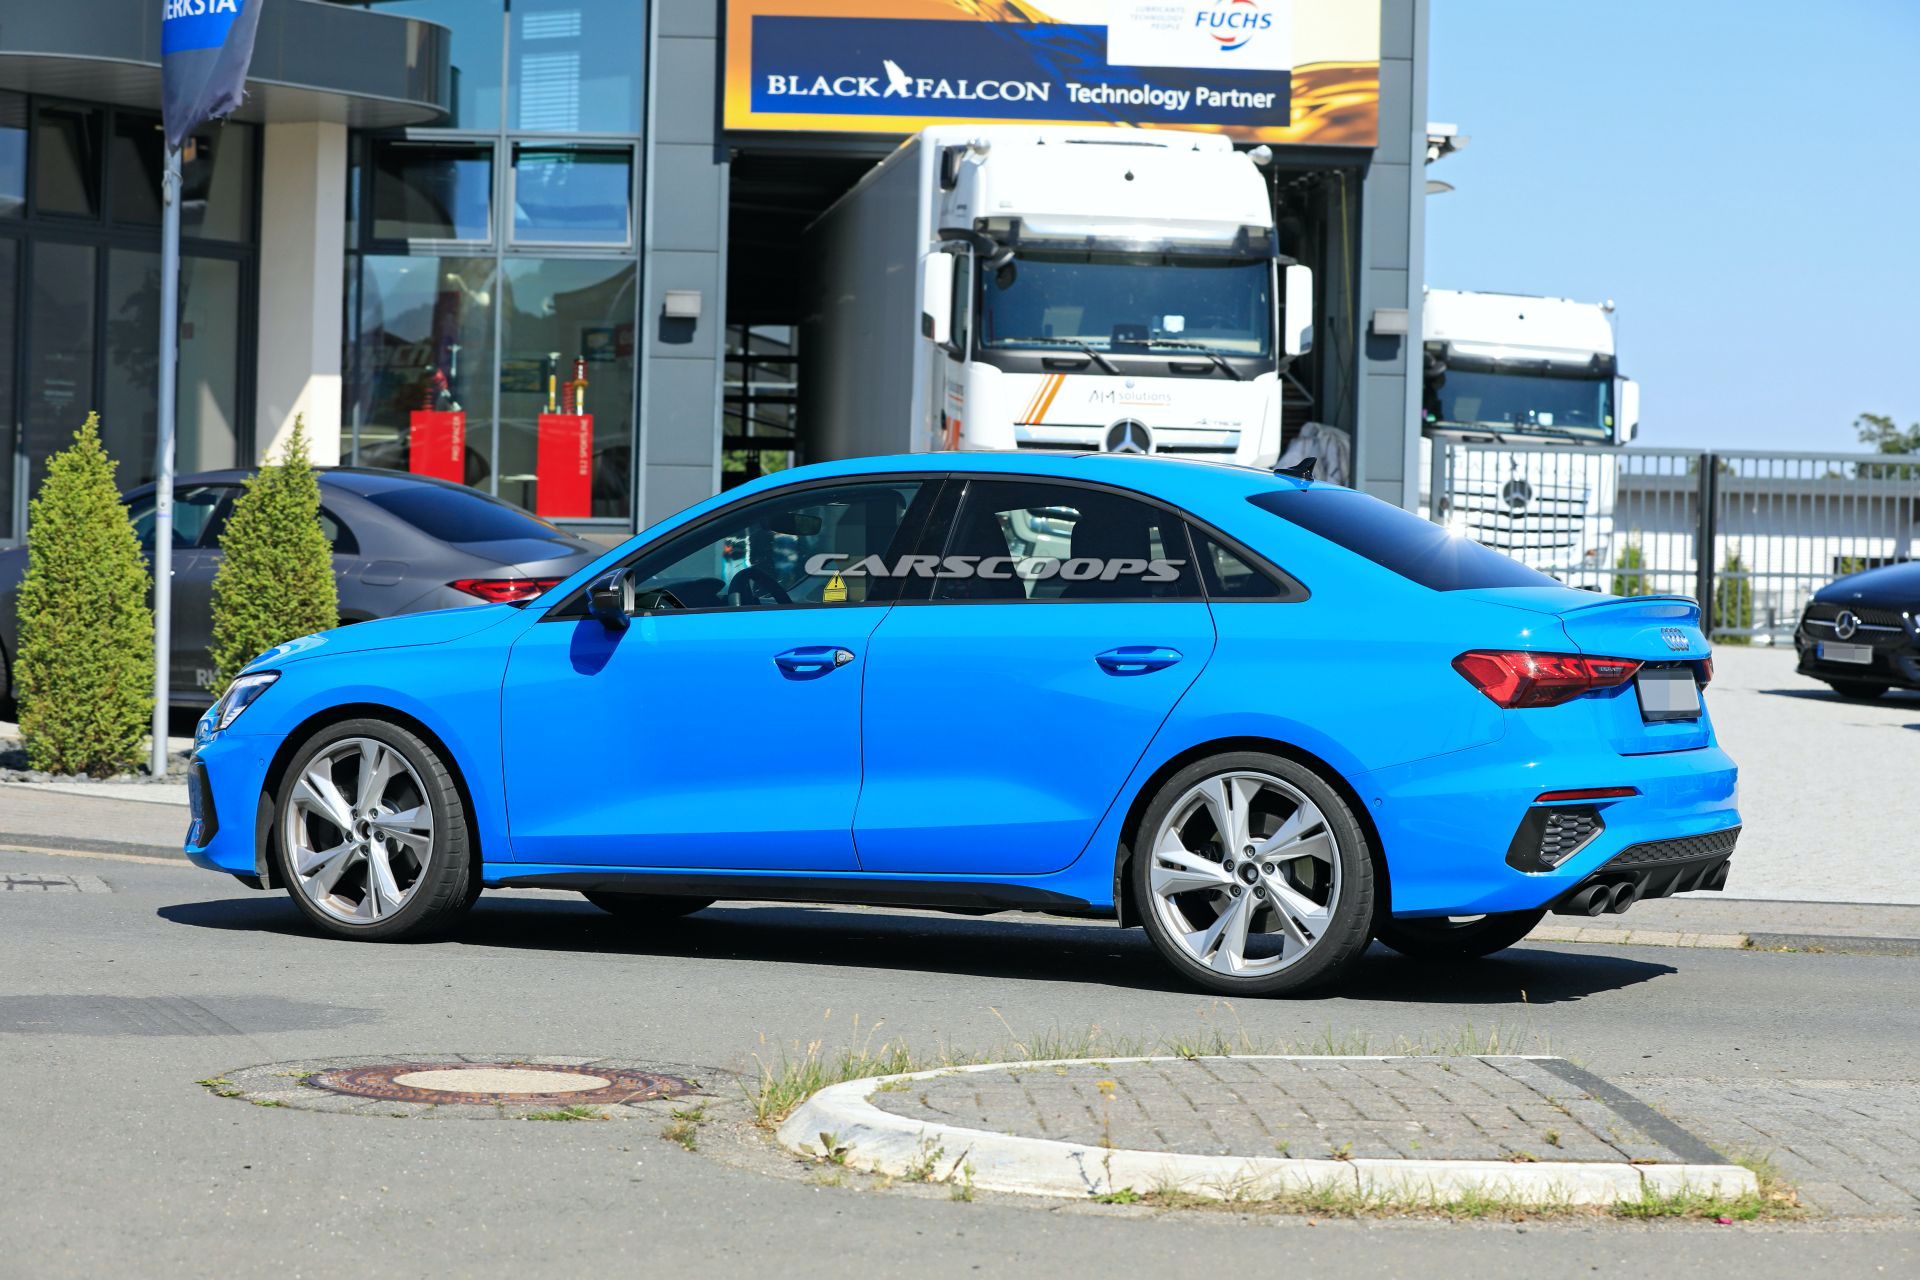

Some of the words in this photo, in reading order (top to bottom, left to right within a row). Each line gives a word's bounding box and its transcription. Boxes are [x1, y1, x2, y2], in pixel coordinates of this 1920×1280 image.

[1195, 11, 1273, 29] FUCHS
[767, 75, 880, 97] BLACK
[915, 79, 1052, 102] FALCON
[1065, 82, 1191, 110] Technology
[1195, 86, 1276, 109] Partner
[1118, 391, 1172, 402] solutions
